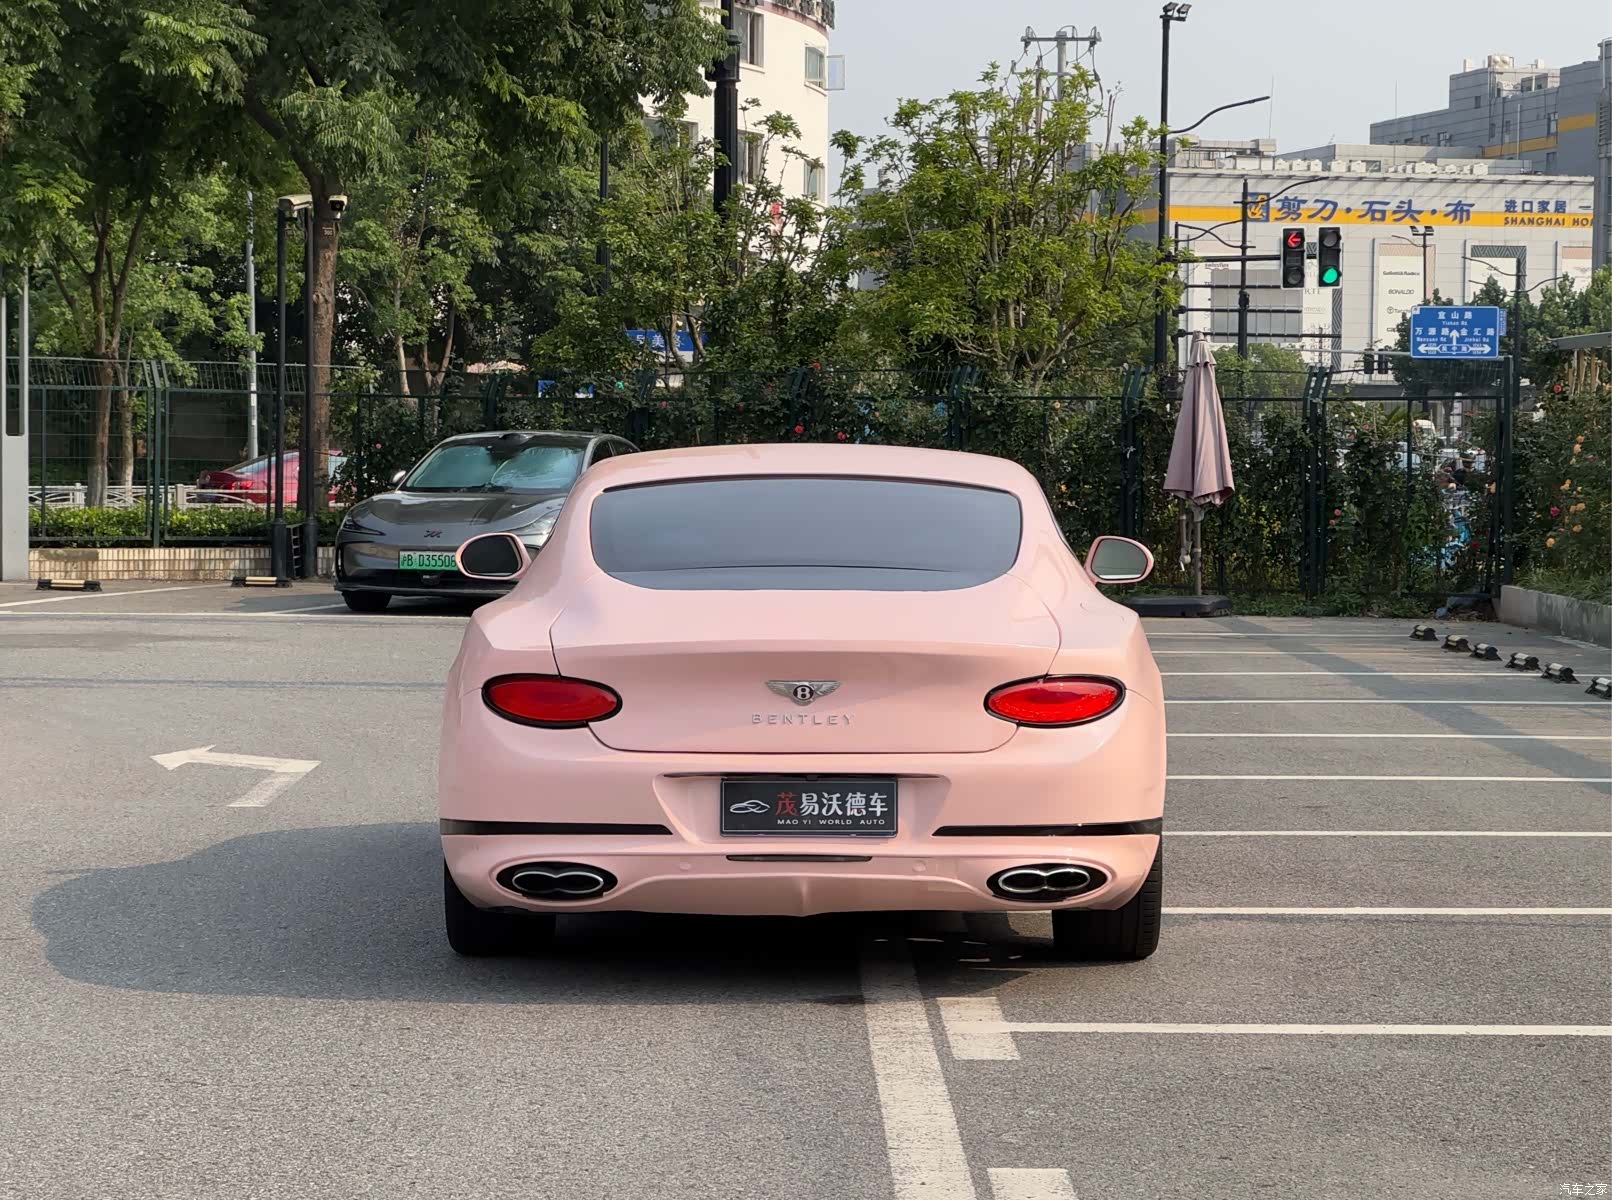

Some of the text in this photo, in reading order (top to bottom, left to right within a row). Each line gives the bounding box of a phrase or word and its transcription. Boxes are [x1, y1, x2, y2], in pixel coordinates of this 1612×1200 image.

[1504, 199, 1567, 213] 进口家居
[1504, 216, 1565, 226] SHANGHAI
[1438, 311, 1472, 319] 宜山路
[1415, 327, 1449, 336] 万源路
[1460, 327, 1495, 336] 金汇路
[752, 714, 854, 725] BENTLEY
[775, 792, 888, 817] 茂易沃德车
